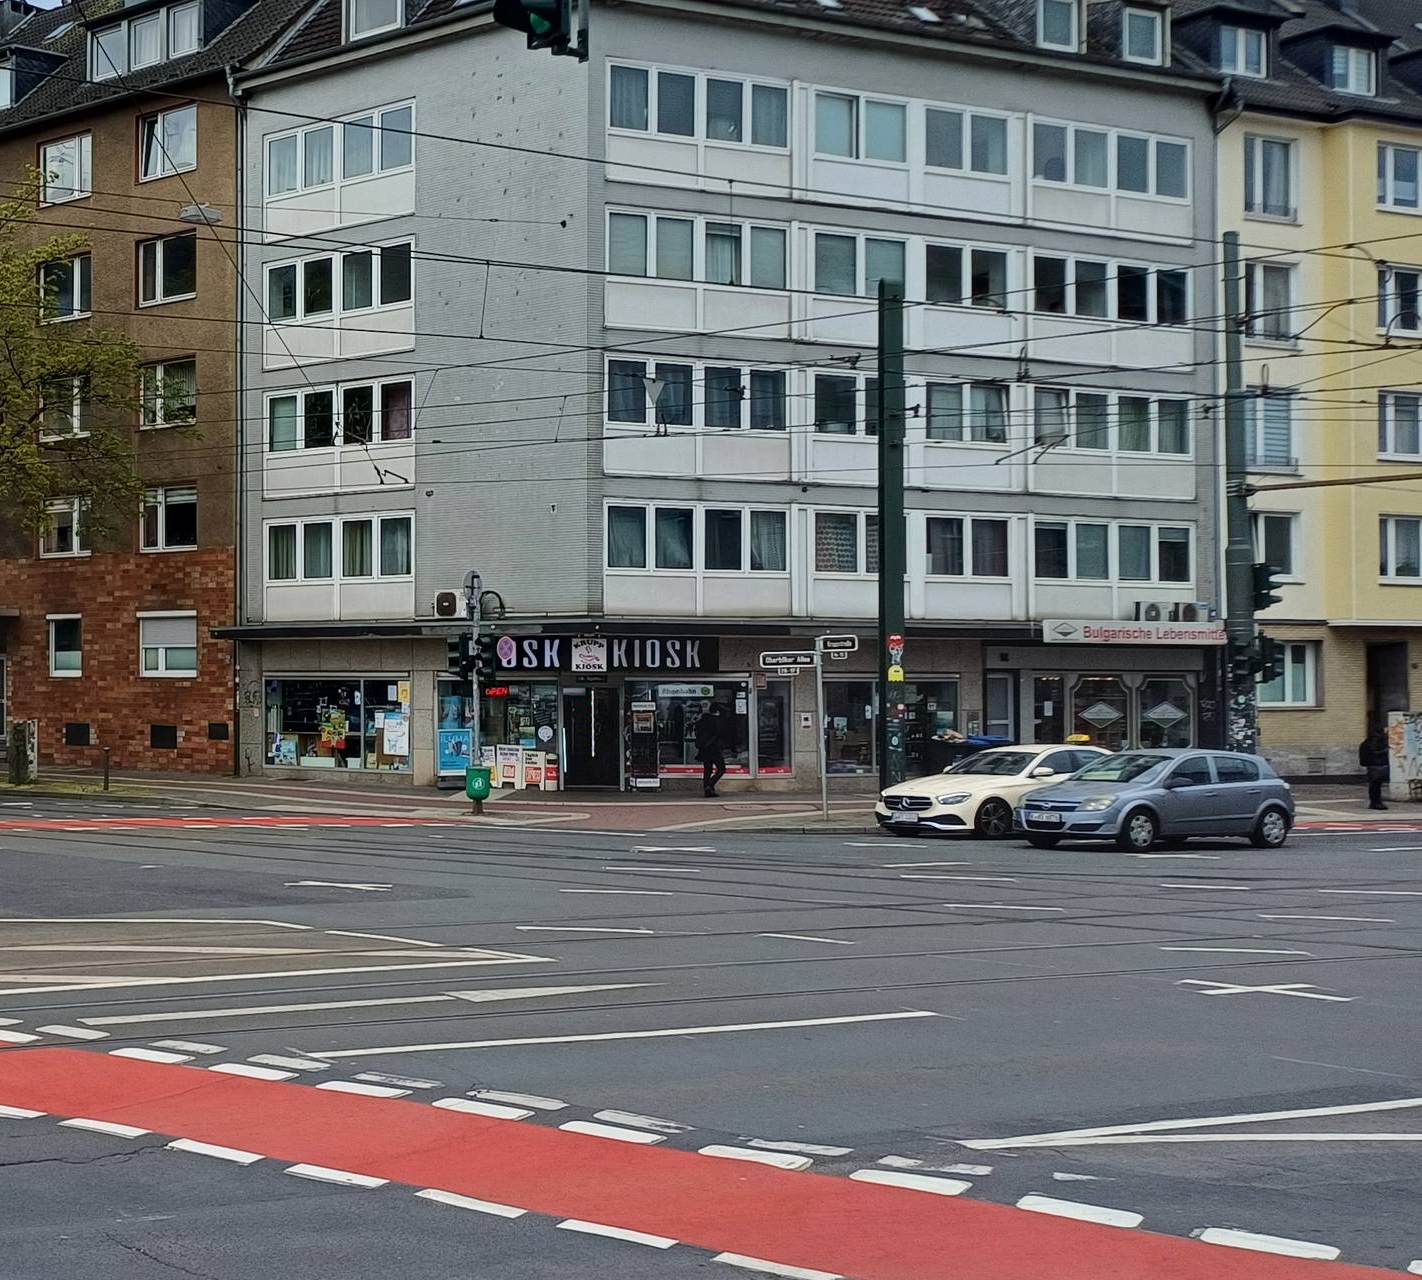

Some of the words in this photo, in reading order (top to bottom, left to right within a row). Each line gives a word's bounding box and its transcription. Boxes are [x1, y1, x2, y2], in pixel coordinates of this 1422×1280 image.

[1083, 625, 1153, 642] Bulgarische
[1156, 627, 1228, 640] Lebensmitte
[573, 640, 605, 649] KRUPP
[613, 639, 701, 668] KIOSK
[485, 687, 508, 697] OPEN
